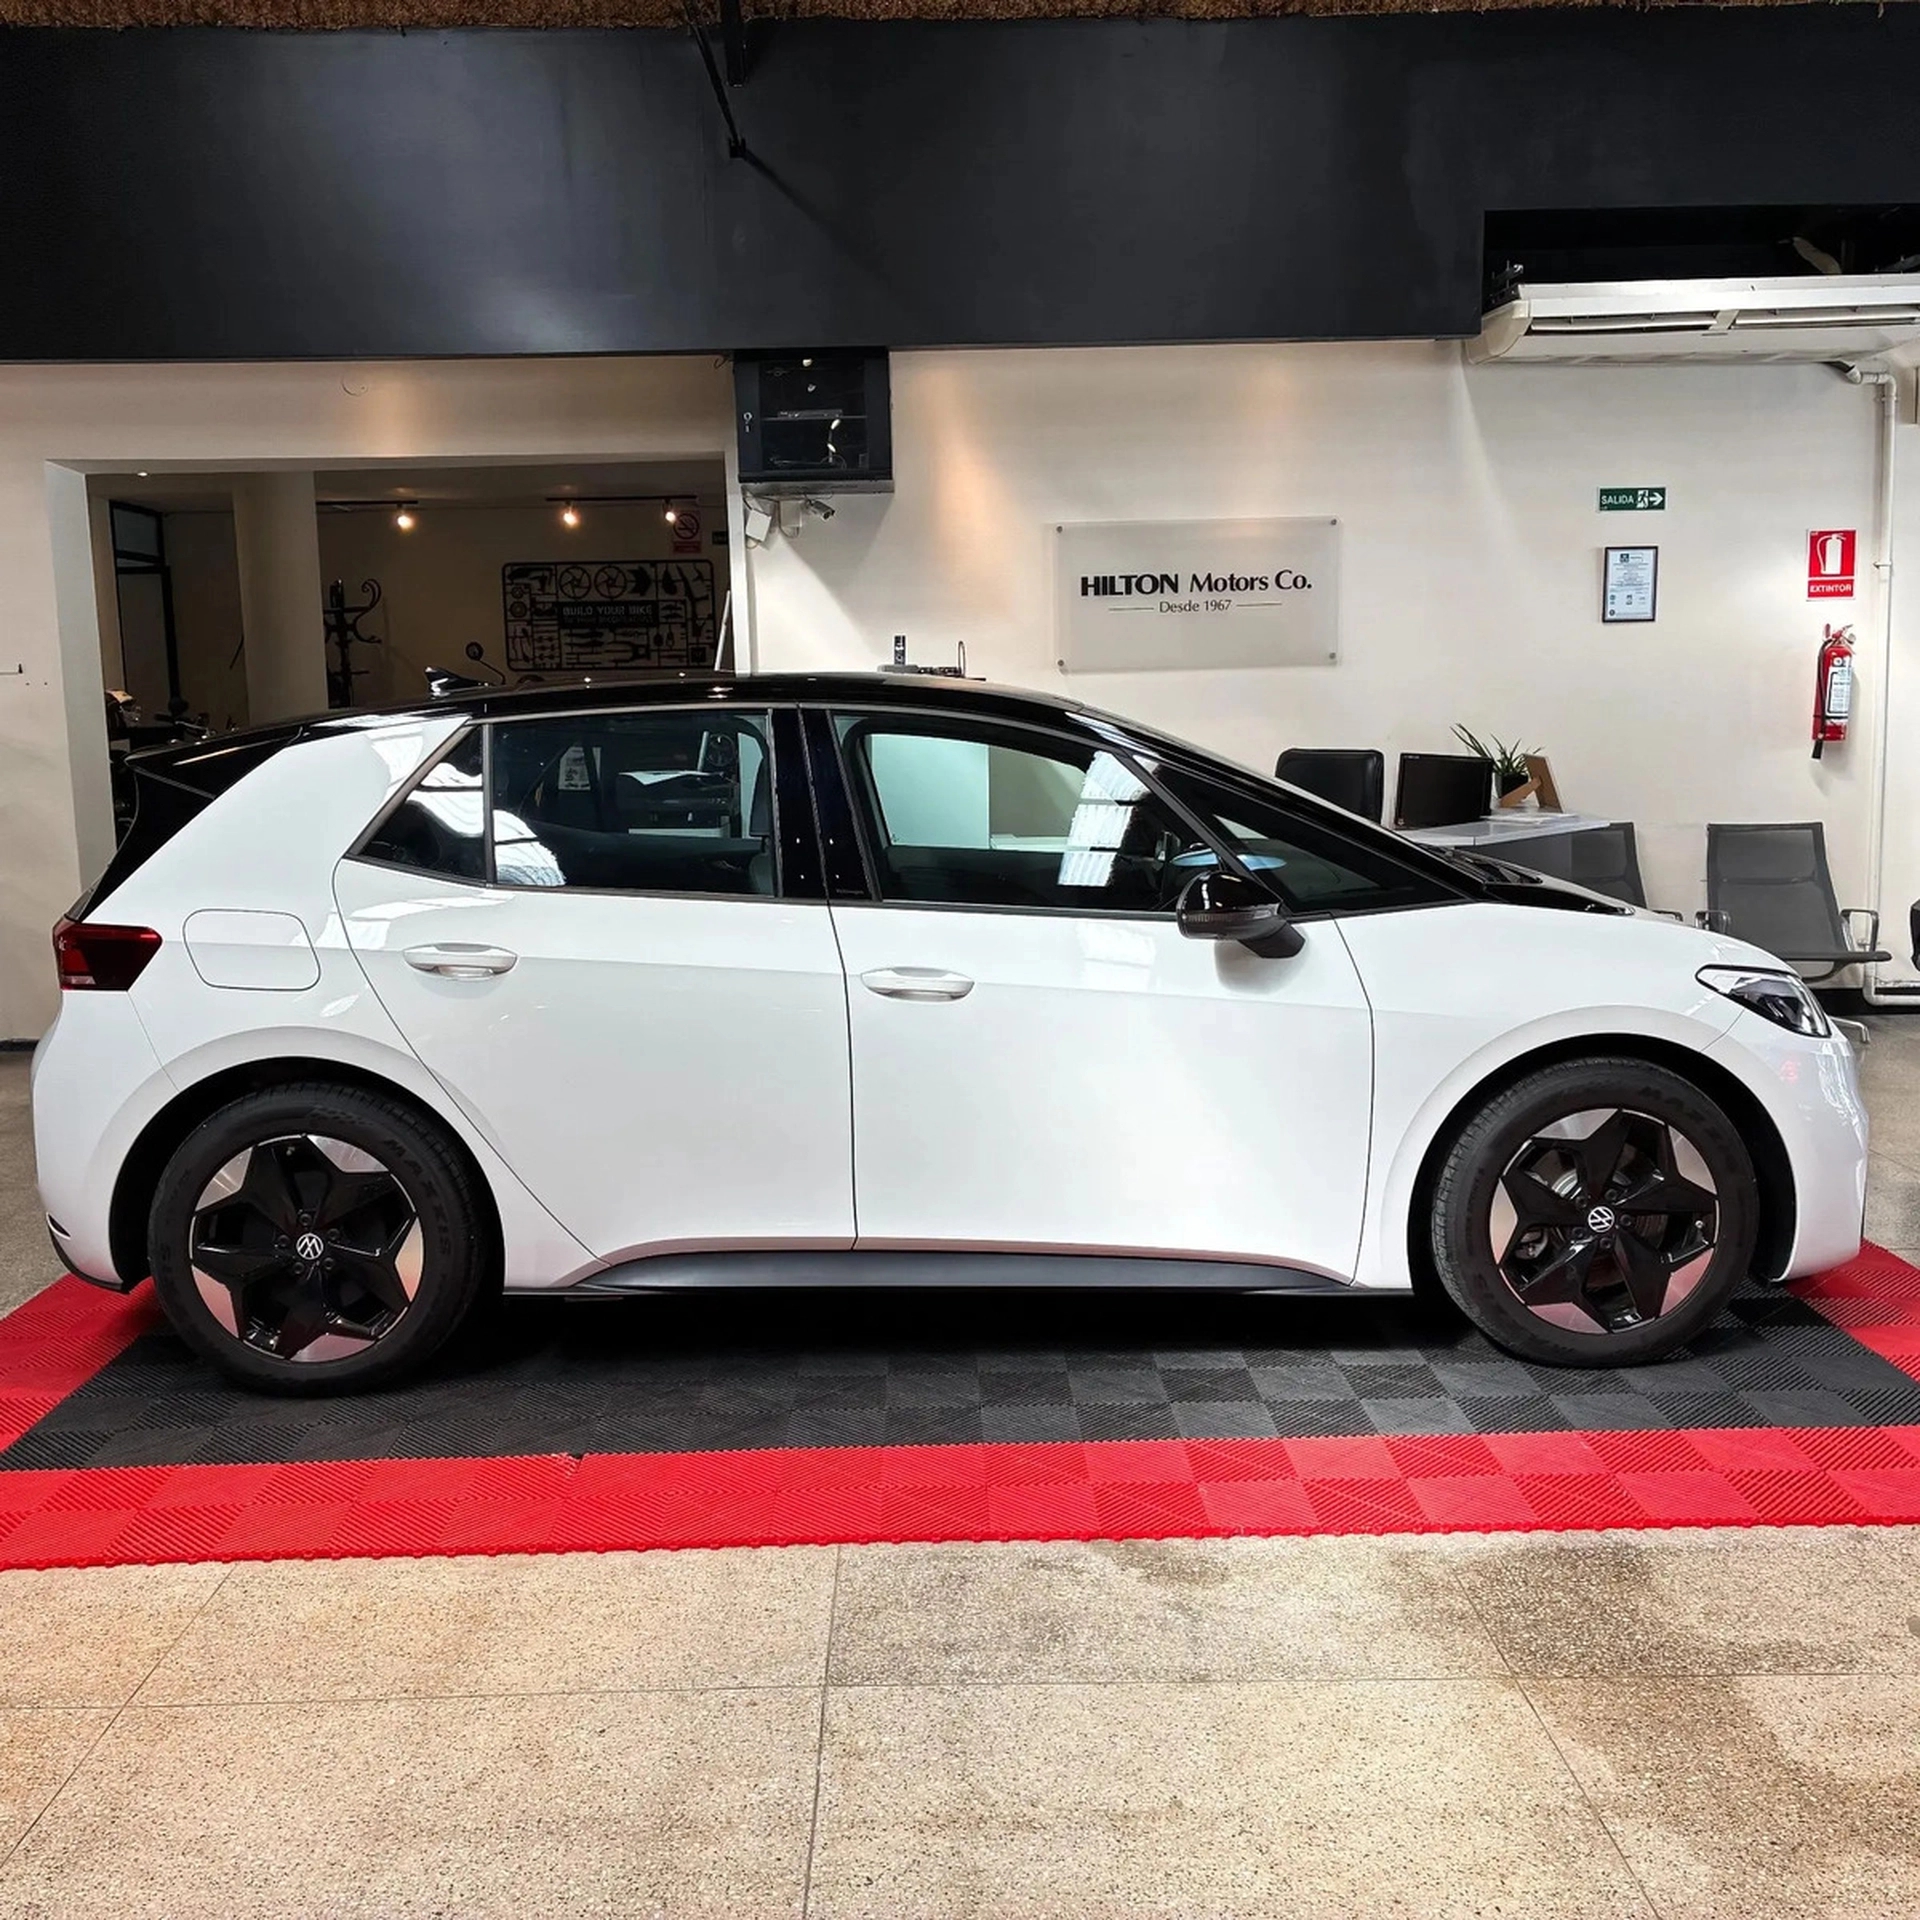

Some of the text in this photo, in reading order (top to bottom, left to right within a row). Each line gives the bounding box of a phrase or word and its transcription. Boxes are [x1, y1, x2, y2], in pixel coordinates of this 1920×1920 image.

[1601, 494, 1634, 505] SALIDA
[1080, 569, 1313, 597] HILTON Motors Co.
[1809, 583, 1852, 593] EXTINTOR
[562, 604, 653, 616] BUILD YOUR BIKE
[1158, 599, 1232, 614] Desde 1967
